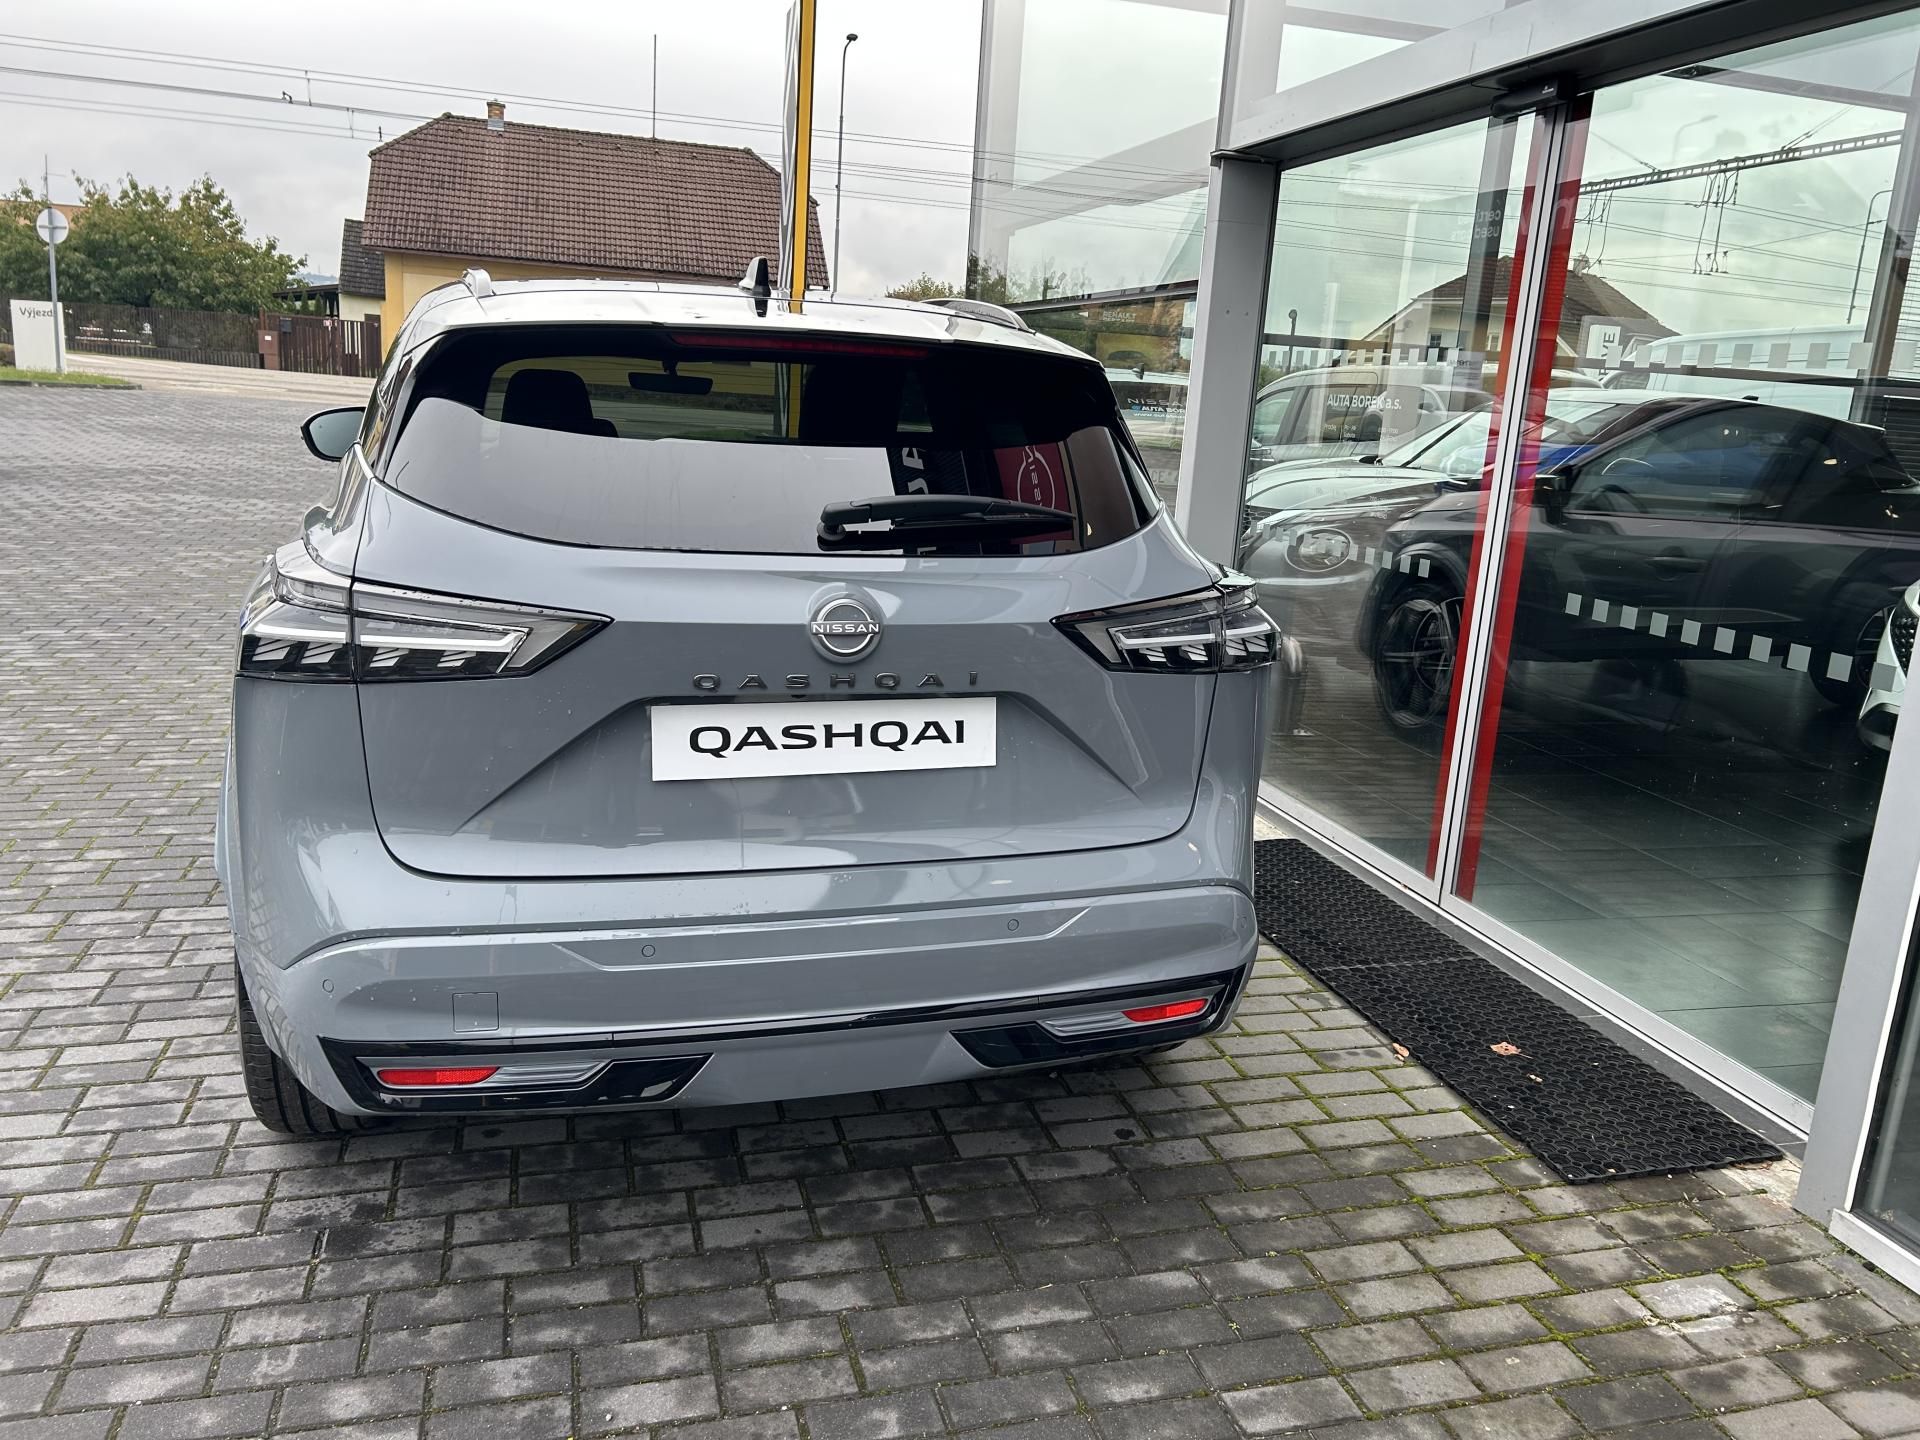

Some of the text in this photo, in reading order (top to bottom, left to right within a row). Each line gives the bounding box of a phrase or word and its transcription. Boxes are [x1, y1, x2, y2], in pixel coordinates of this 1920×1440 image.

[19, 306, 53, 319] Výjezd
[1127, 397, 1183, 407] NISSA
[1327, 394, 1402, 410] AUTA BOREK a.s.
[812, 623, 879, 633] NISSAN
[692, 671, 979, 693] QASHQAI
[689, 719, 965, 759] QASHQAI
